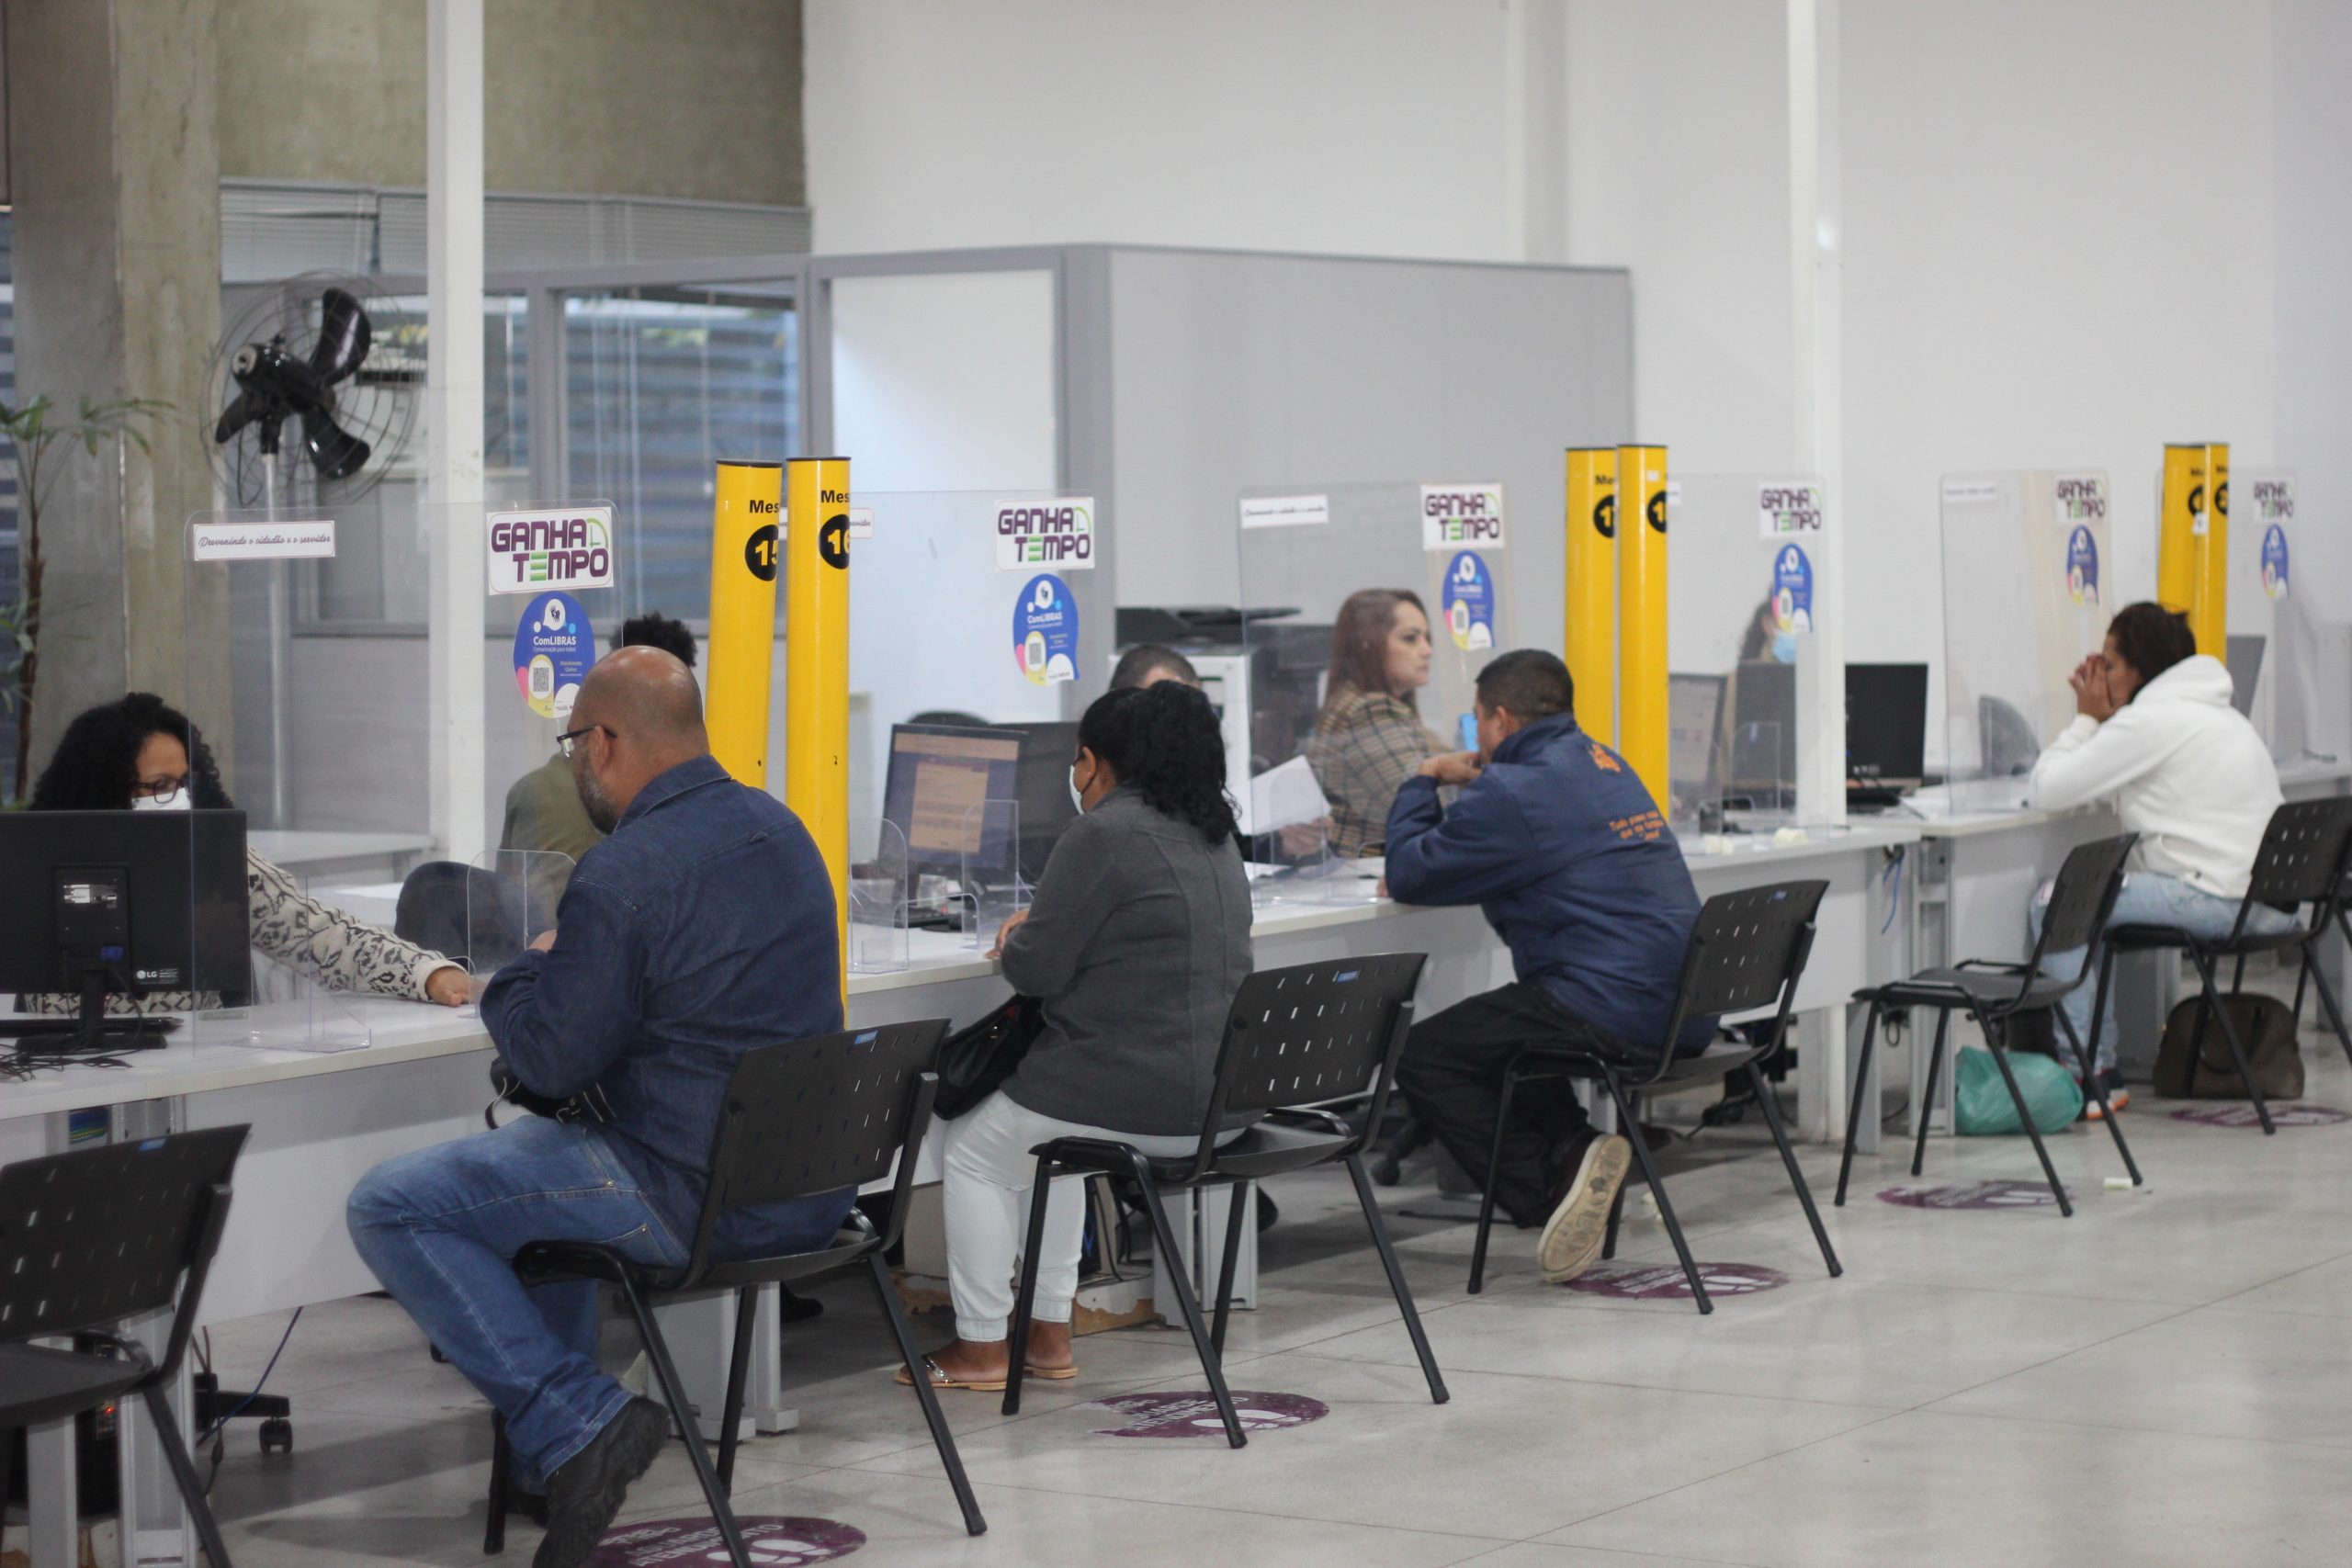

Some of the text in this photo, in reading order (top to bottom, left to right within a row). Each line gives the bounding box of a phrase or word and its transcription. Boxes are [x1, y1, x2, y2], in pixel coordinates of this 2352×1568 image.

[1425, 493, 1486, 516] GANHA
[1761, 489, 1810, 509] GANHA
[998, 507, 1074, 535] GANHA
[1439, 518, 1500, 541] TEMPO
[1772, 511, 1822, 532] TEMPO
[300, 534, 332, 544] servidor
[492, 519, 587, 552] GANHA
[1014, 534, 1091, 562] TEMPO
[513, 548, 609, 582] TEMPO
[533, 636, 577, 646] ComLIBRAS
